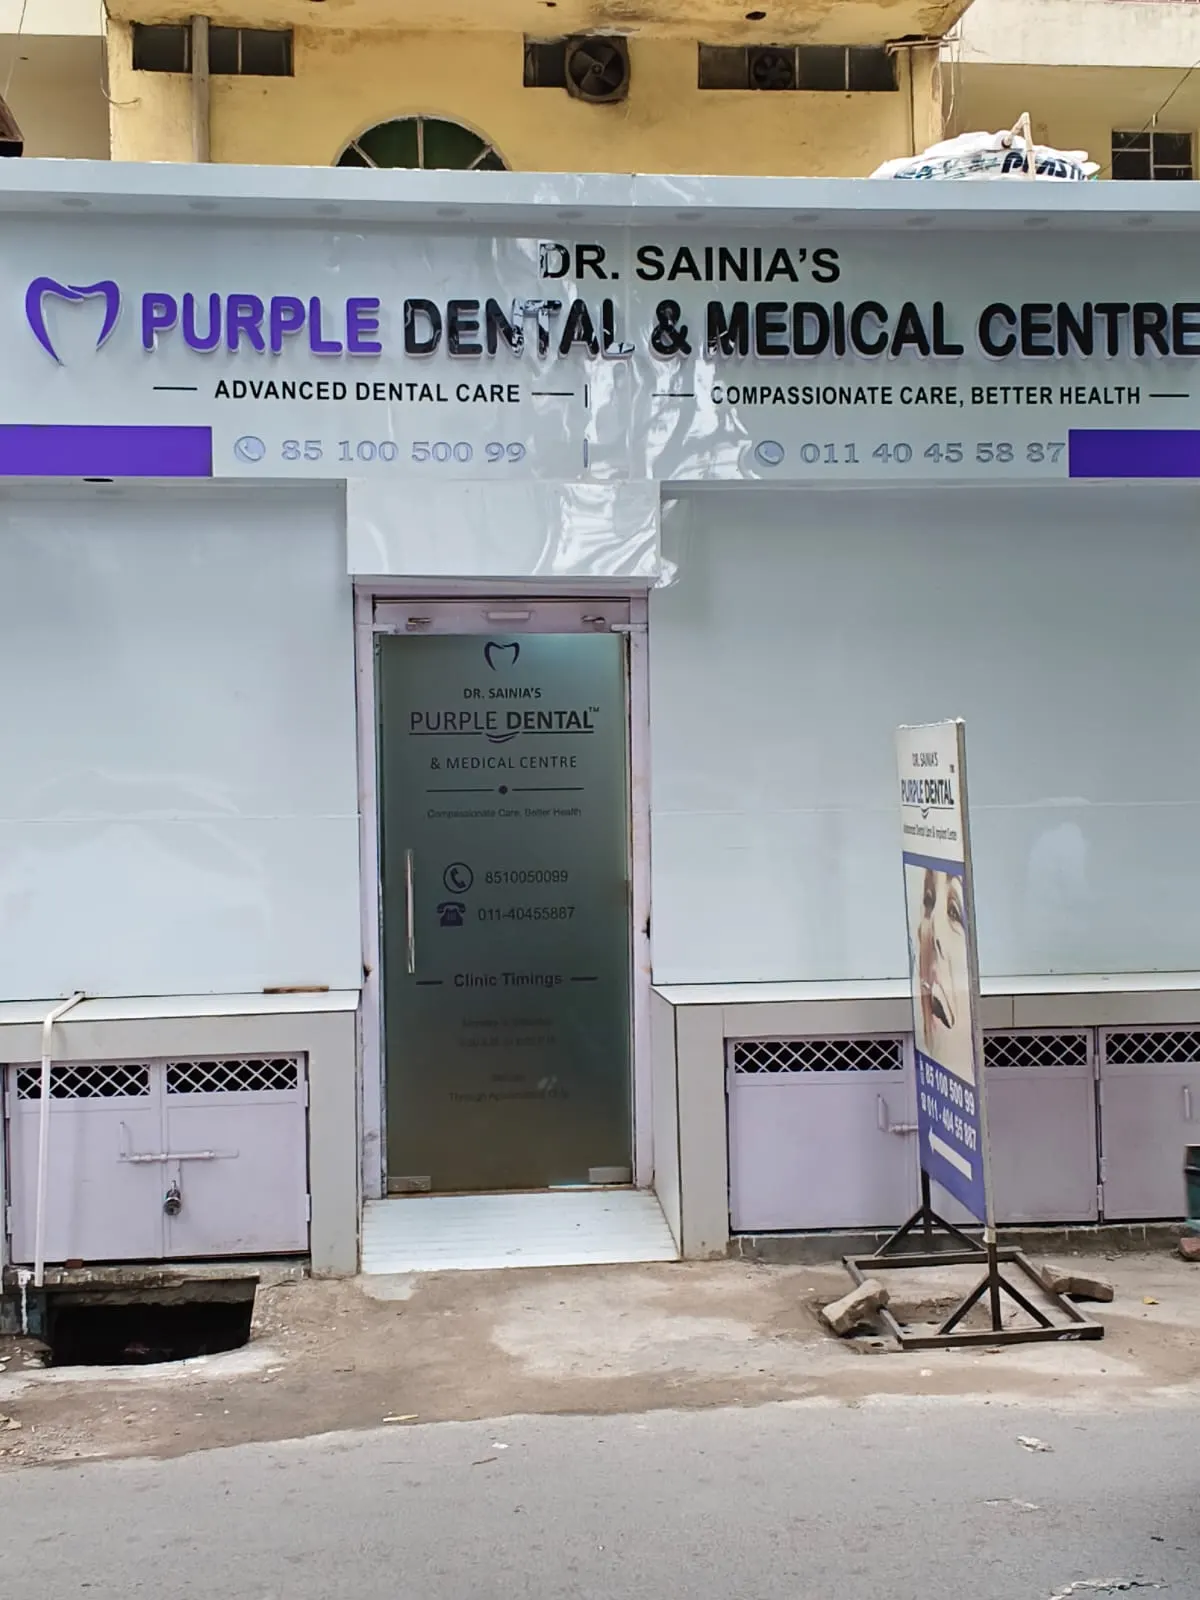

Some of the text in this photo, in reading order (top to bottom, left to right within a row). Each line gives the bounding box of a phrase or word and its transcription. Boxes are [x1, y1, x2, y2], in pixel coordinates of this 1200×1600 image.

[539, 243, 840, 282] DR. SAINIA'S
[142, 293, 1200, 358] PURPLE DENTAL & MEDICAL CENTRE
[214, 380, 520, 403] ADVANCED DENTAL CARE
[711, 386, 1140, 407] COMPASSIONATE CARE, BETTER HEALTH
[281, 439, 527, 463] 85 100 500 99
[800, 441, 1067, 464] 011 40 45 58 87
[463, 686, 542, 699] DR. SAINIA'S
[410, 711, 497, 731] PURPLE
[506, 710, 595, 730] DENTAL
[430, 756, 578, 770] & MEDICAL CENTRE
[924, 779, 954, 805] DENTAL
[485, 870, 569, 884] 8510050099
[478, 906, 576, 921] 011-40455887
[453, 972, 563, 989] Clinic Timings
